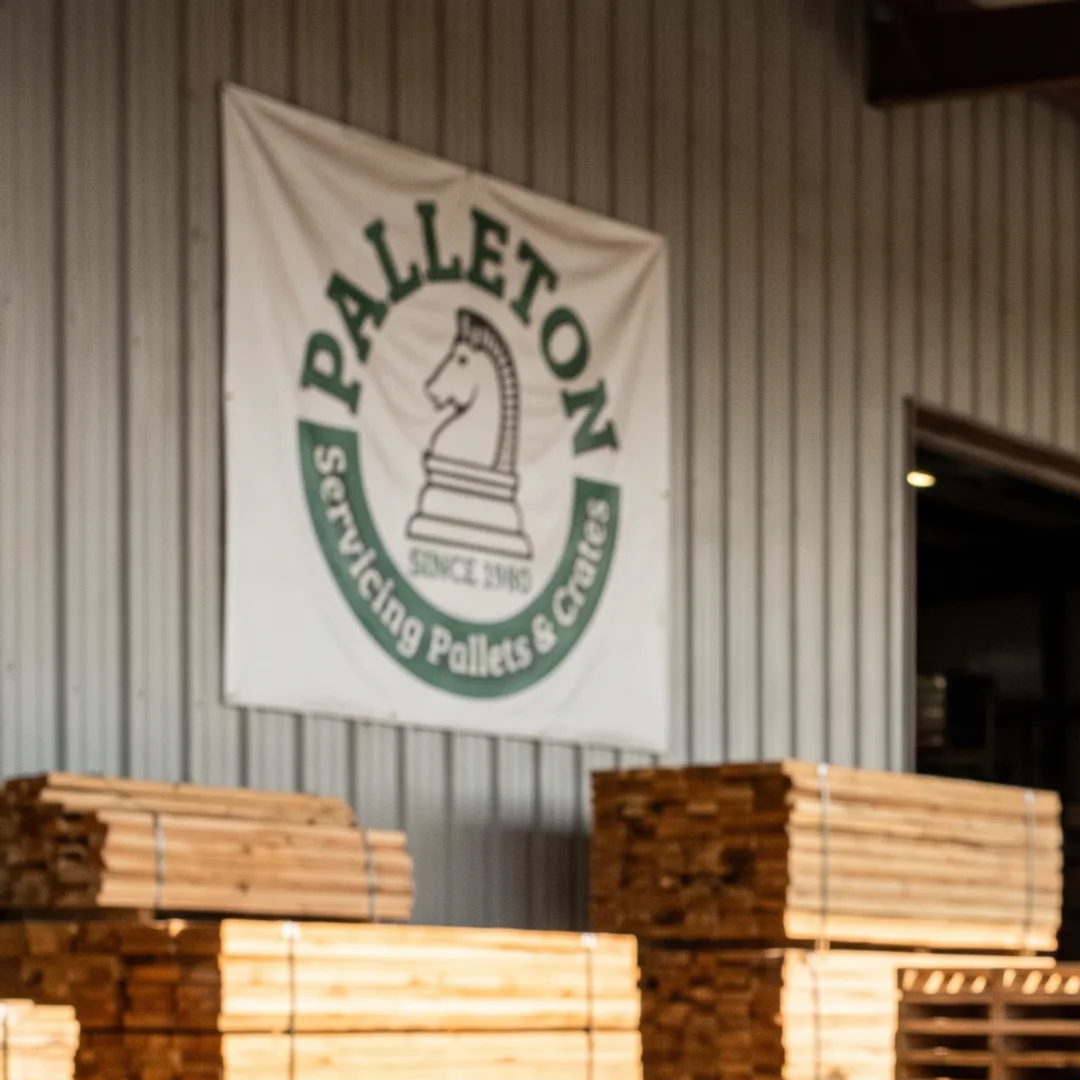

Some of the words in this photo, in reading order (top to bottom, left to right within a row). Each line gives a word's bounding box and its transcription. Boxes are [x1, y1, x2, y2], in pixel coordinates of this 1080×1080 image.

[301, 201, 620, 457] PALLETON
[314, 446, 424, 659] Servicing
[427, 623, 533, 677] Pallets
[532, 613, 558, 655] &
[551, 498, 611, 628] Crates
[409, 548, 478, 588] SINCE
